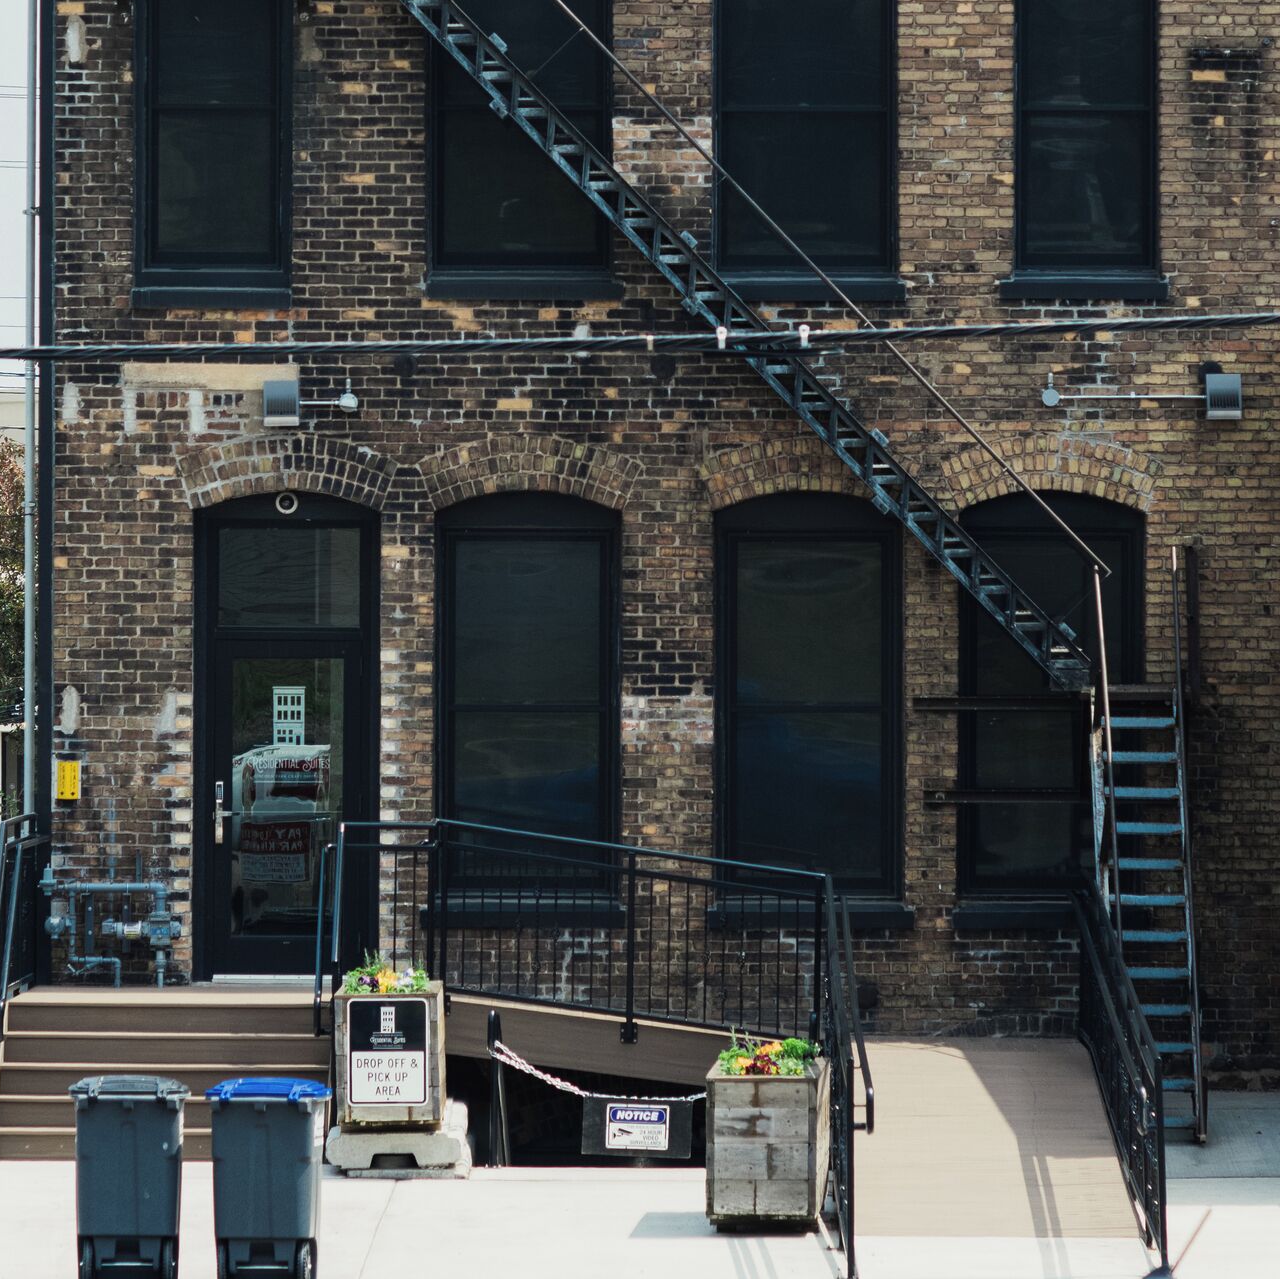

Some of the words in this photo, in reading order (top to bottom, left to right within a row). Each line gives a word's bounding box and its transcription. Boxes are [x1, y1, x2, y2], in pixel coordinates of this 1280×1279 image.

[248, 756, 300, 773] RESIDENTIAL
[302, 756, 330, 772] SUITES
[356, 1058, 383, 1069] DROP
[388, 1058, 407, 1069] OFF
[410, 1058, 418, 1069] &
[367, 1072, 390, 1082] PICK
[394, 1072, 408, 1082] UP
[375, 1086, 401, 1096] AREA
[616, 1110, 659, 1121] NOTICE
